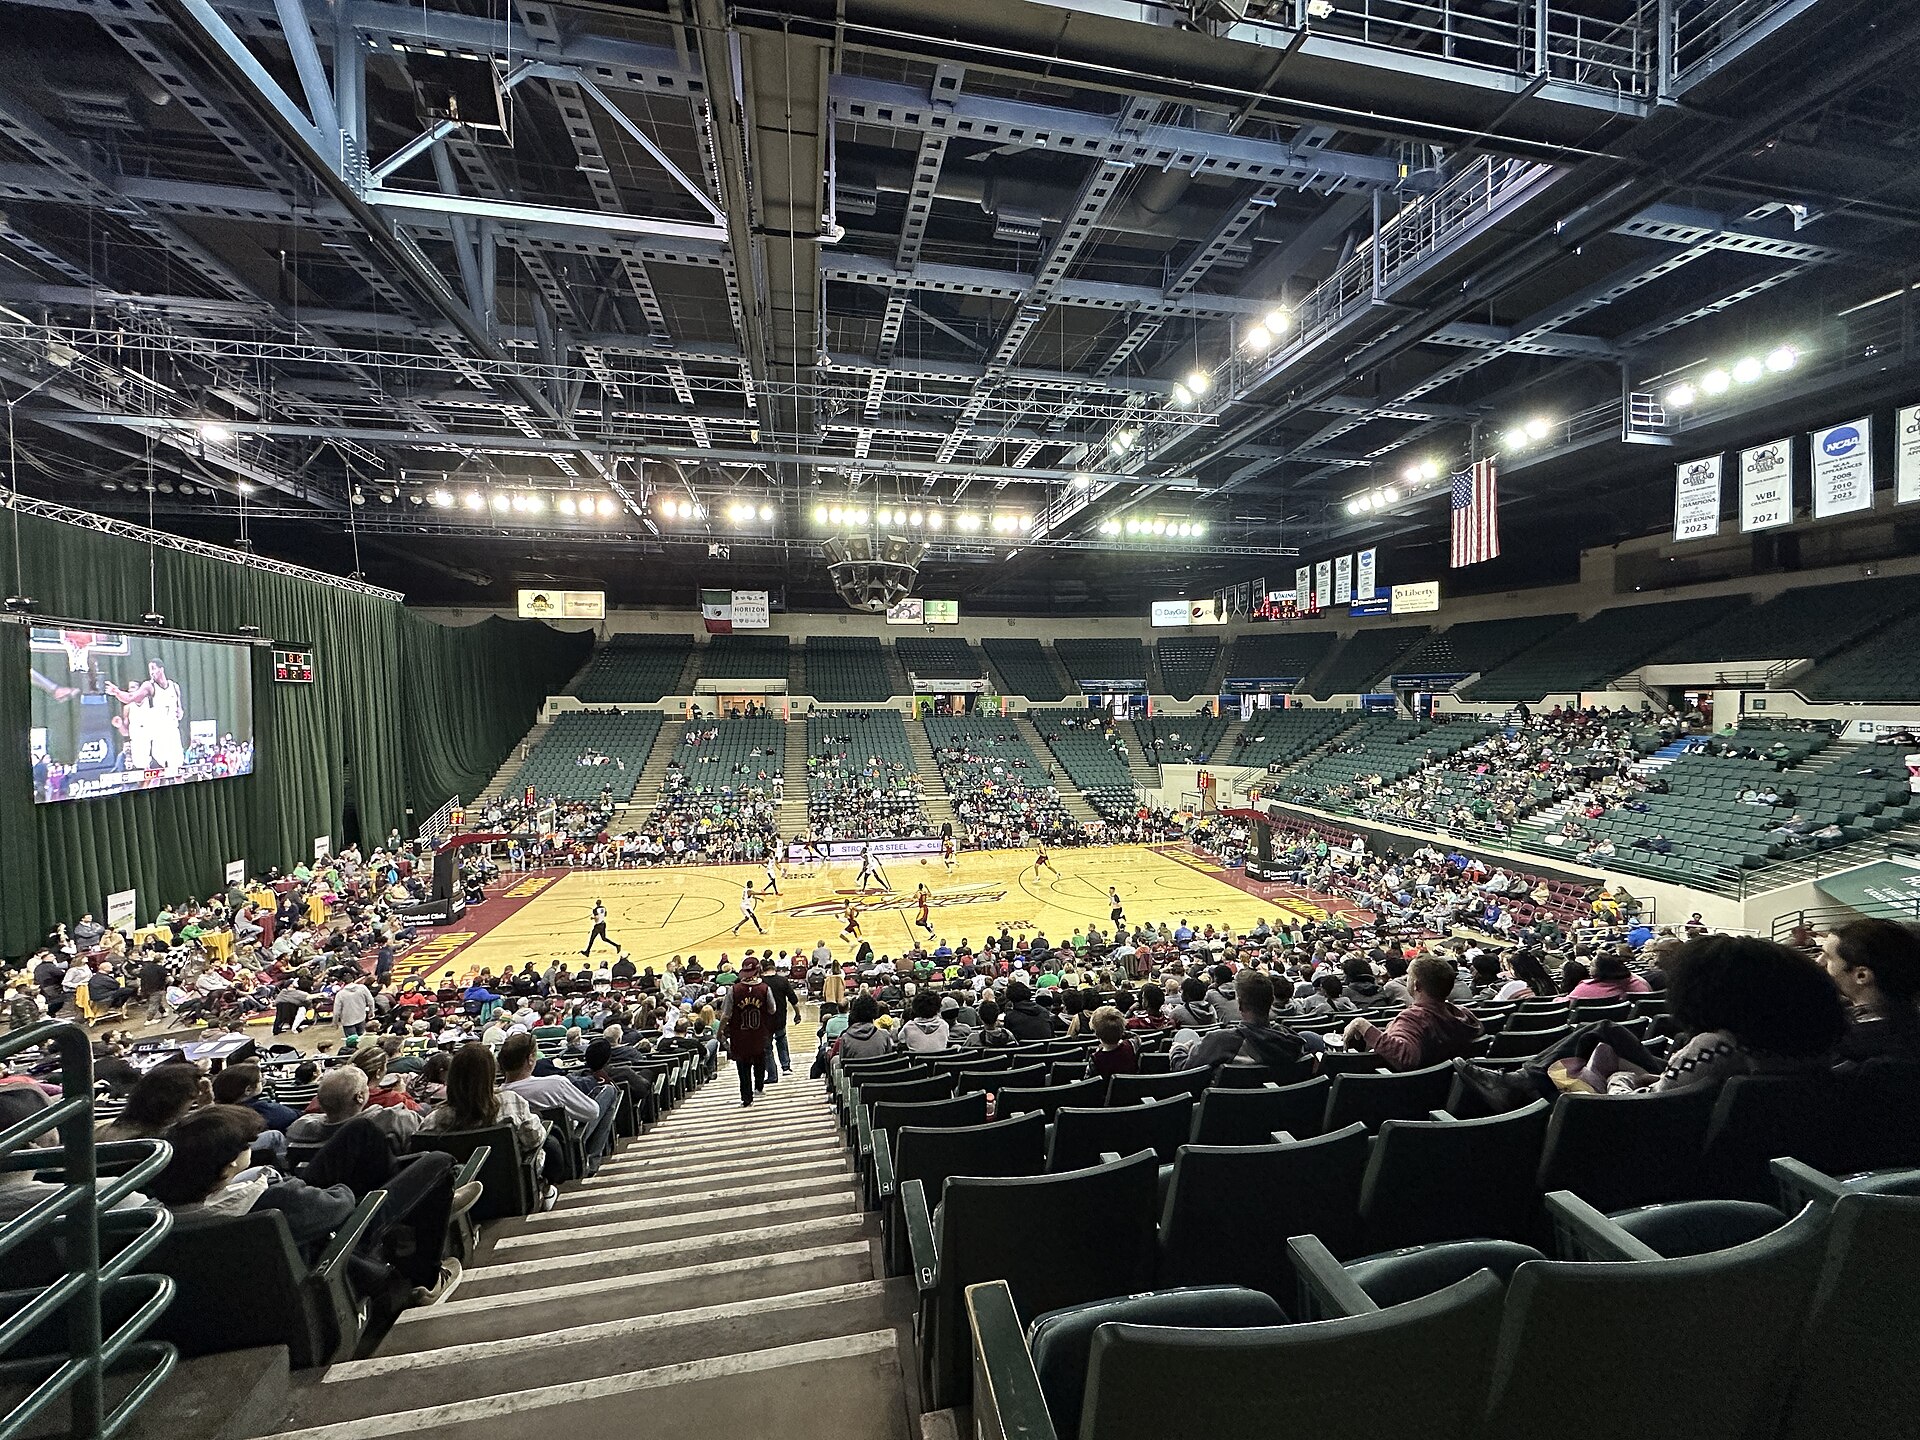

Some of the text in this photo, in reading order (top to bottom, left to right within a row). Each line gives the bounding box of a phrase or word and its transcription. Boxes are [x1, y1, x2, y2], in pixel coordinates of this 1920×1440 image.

[1826, 437, 1860, 452] NCAA
[1822, 462, 1863, 475] APPEARANCES
[1832, 472, 1852, 481] 2008
[1832, 482, 1852, 491] 2010
[1756, 491, 1776, 501] WBI
[1832, 492, 1852, 500] 2023
[1680, 497, 1717, 508] CHAMPIONS
[1693, 514, 1716, 523] ROUND
[1752, 512, 1778, 524] 2021
[1684, 524, 1708, 534] 2023
[1164, 608, 1187, 616] DayGlo
[842, 844, 873, 853] STROG
[886, 843, 908, 851] STEEL
[430, 912, 447, 920] Clinic
[1169, 908, 1222, 916] ROCKET
[741, 1009, 760, 1030] 10
